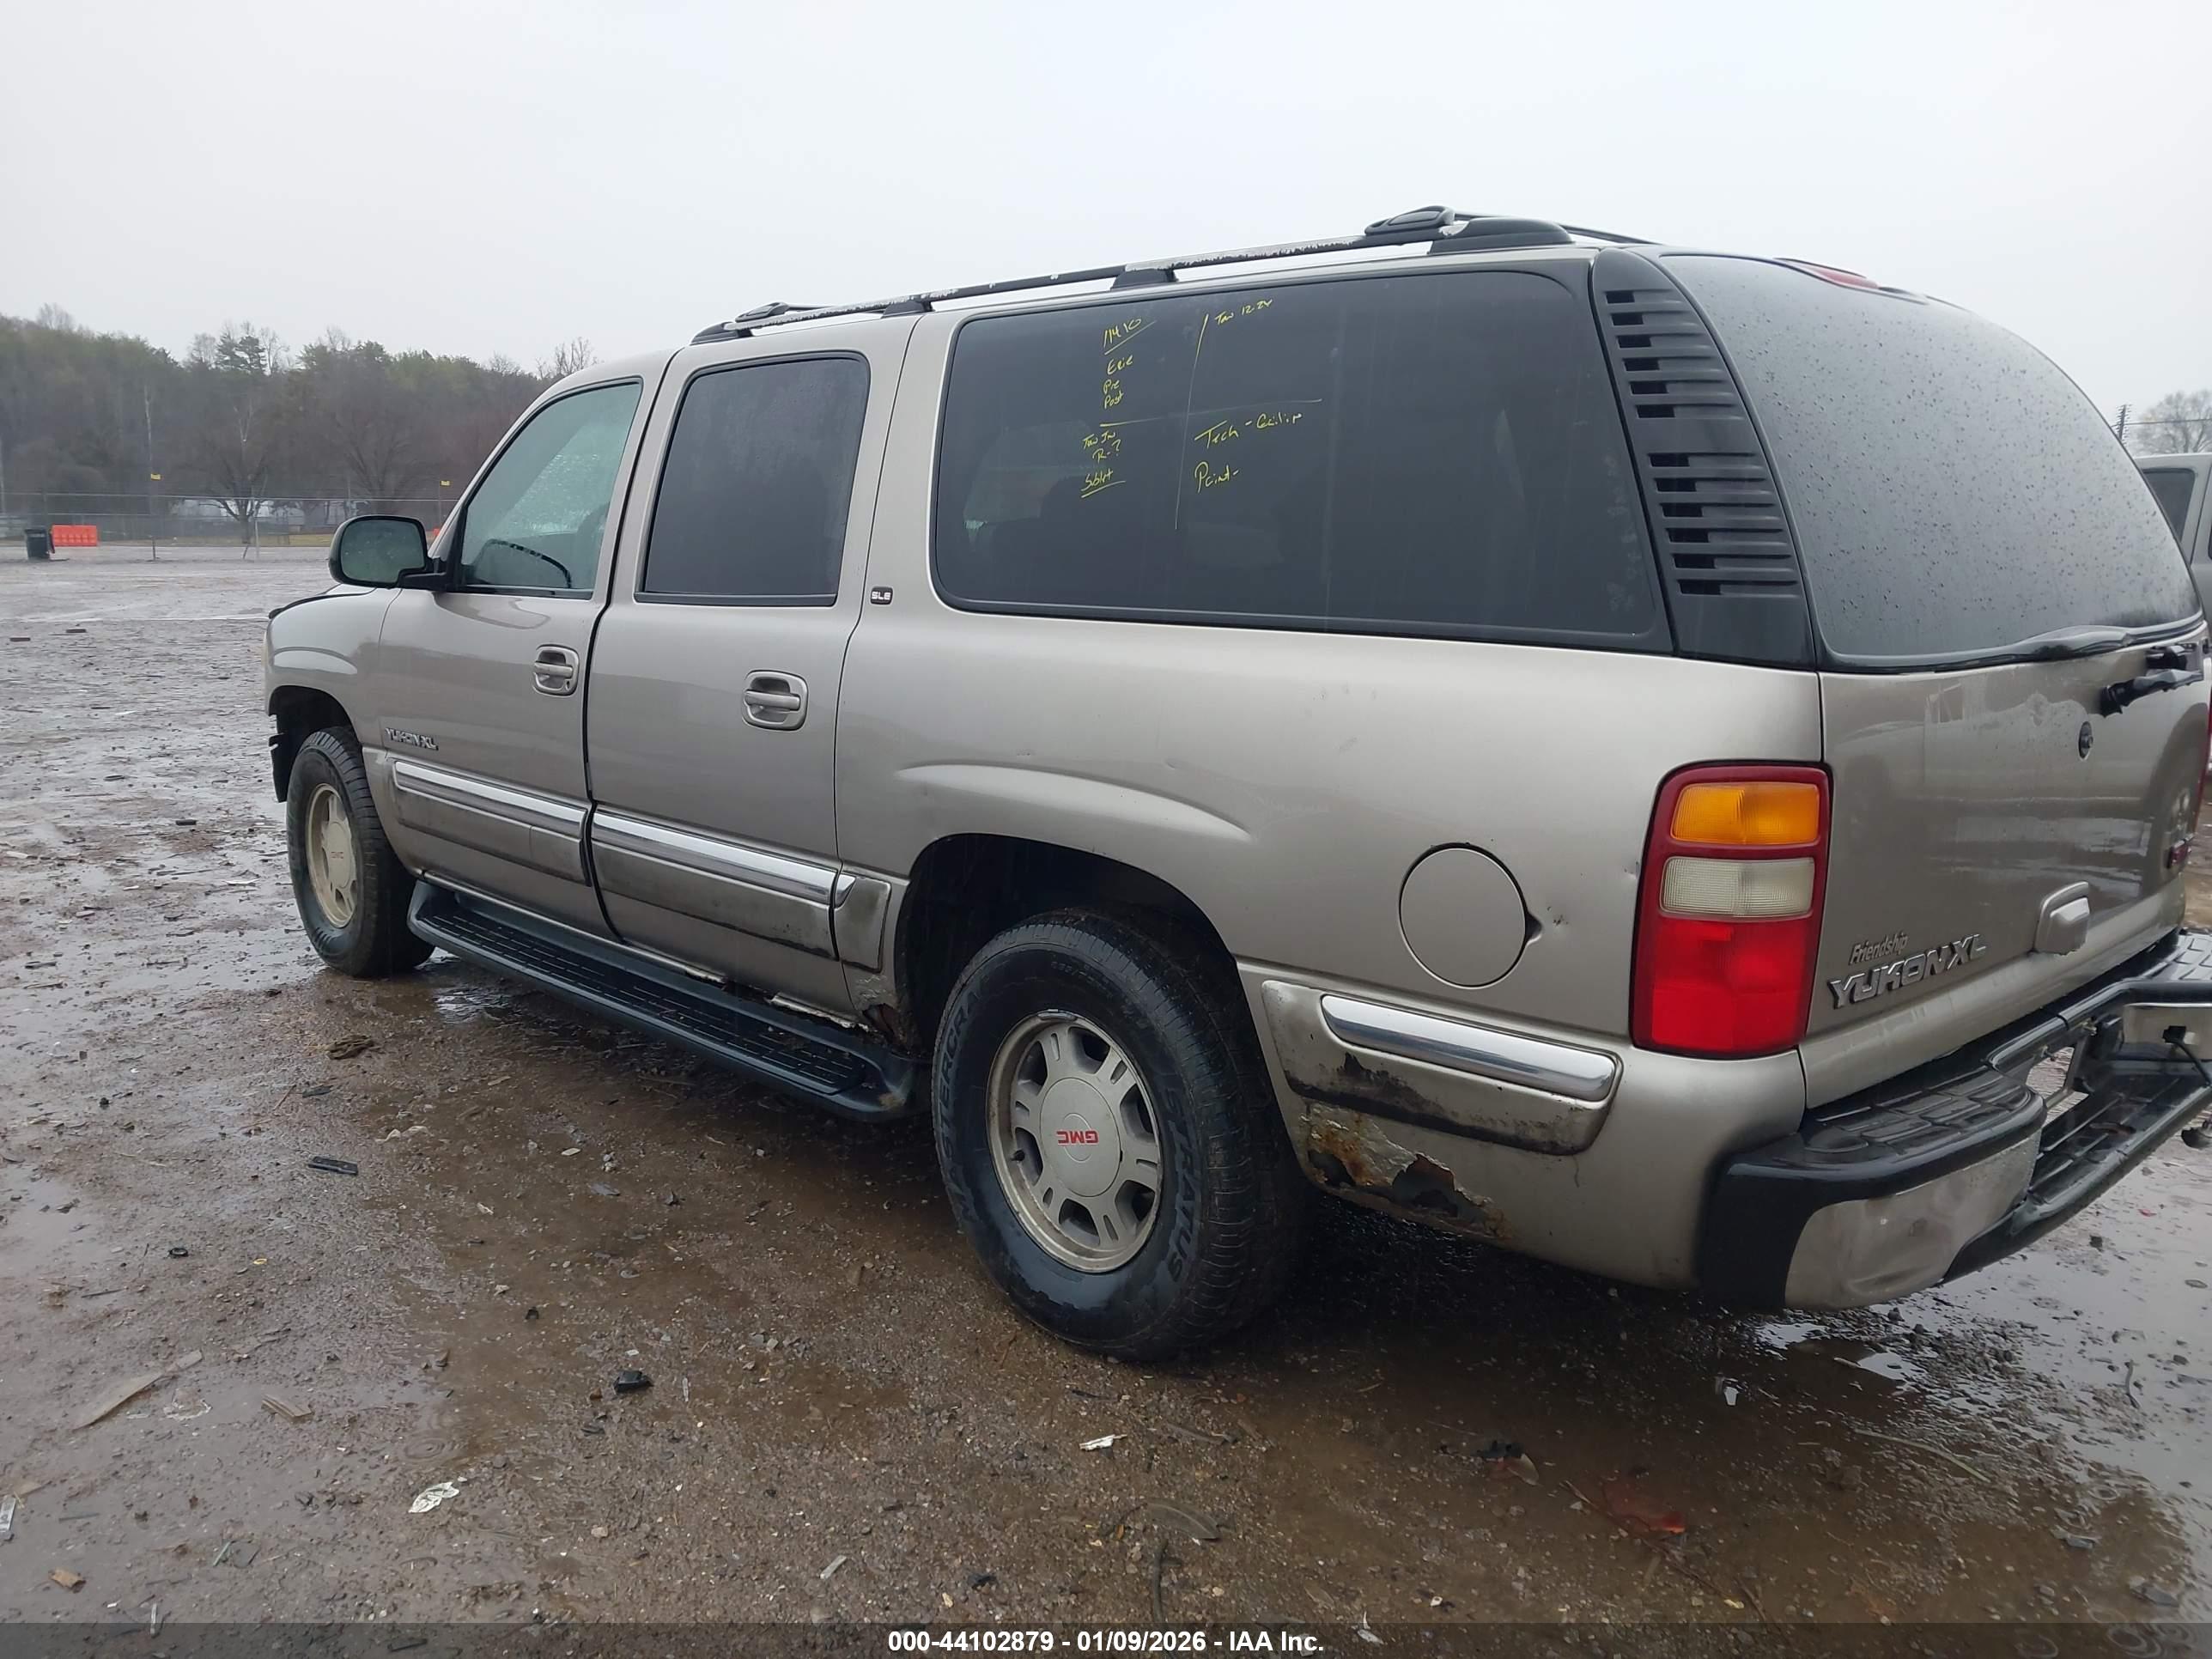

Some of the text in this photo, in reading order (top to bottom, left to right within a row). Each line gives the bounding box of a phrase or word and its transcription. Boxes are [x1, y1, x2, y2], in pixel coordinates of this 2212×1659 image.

[1194, 420, 1239, 449] Tech
[872, 591, 891, 601] SLE
[1849, 930, 1910, 966] Friendship
[1056, 1130, 1099, 1146] GMC
